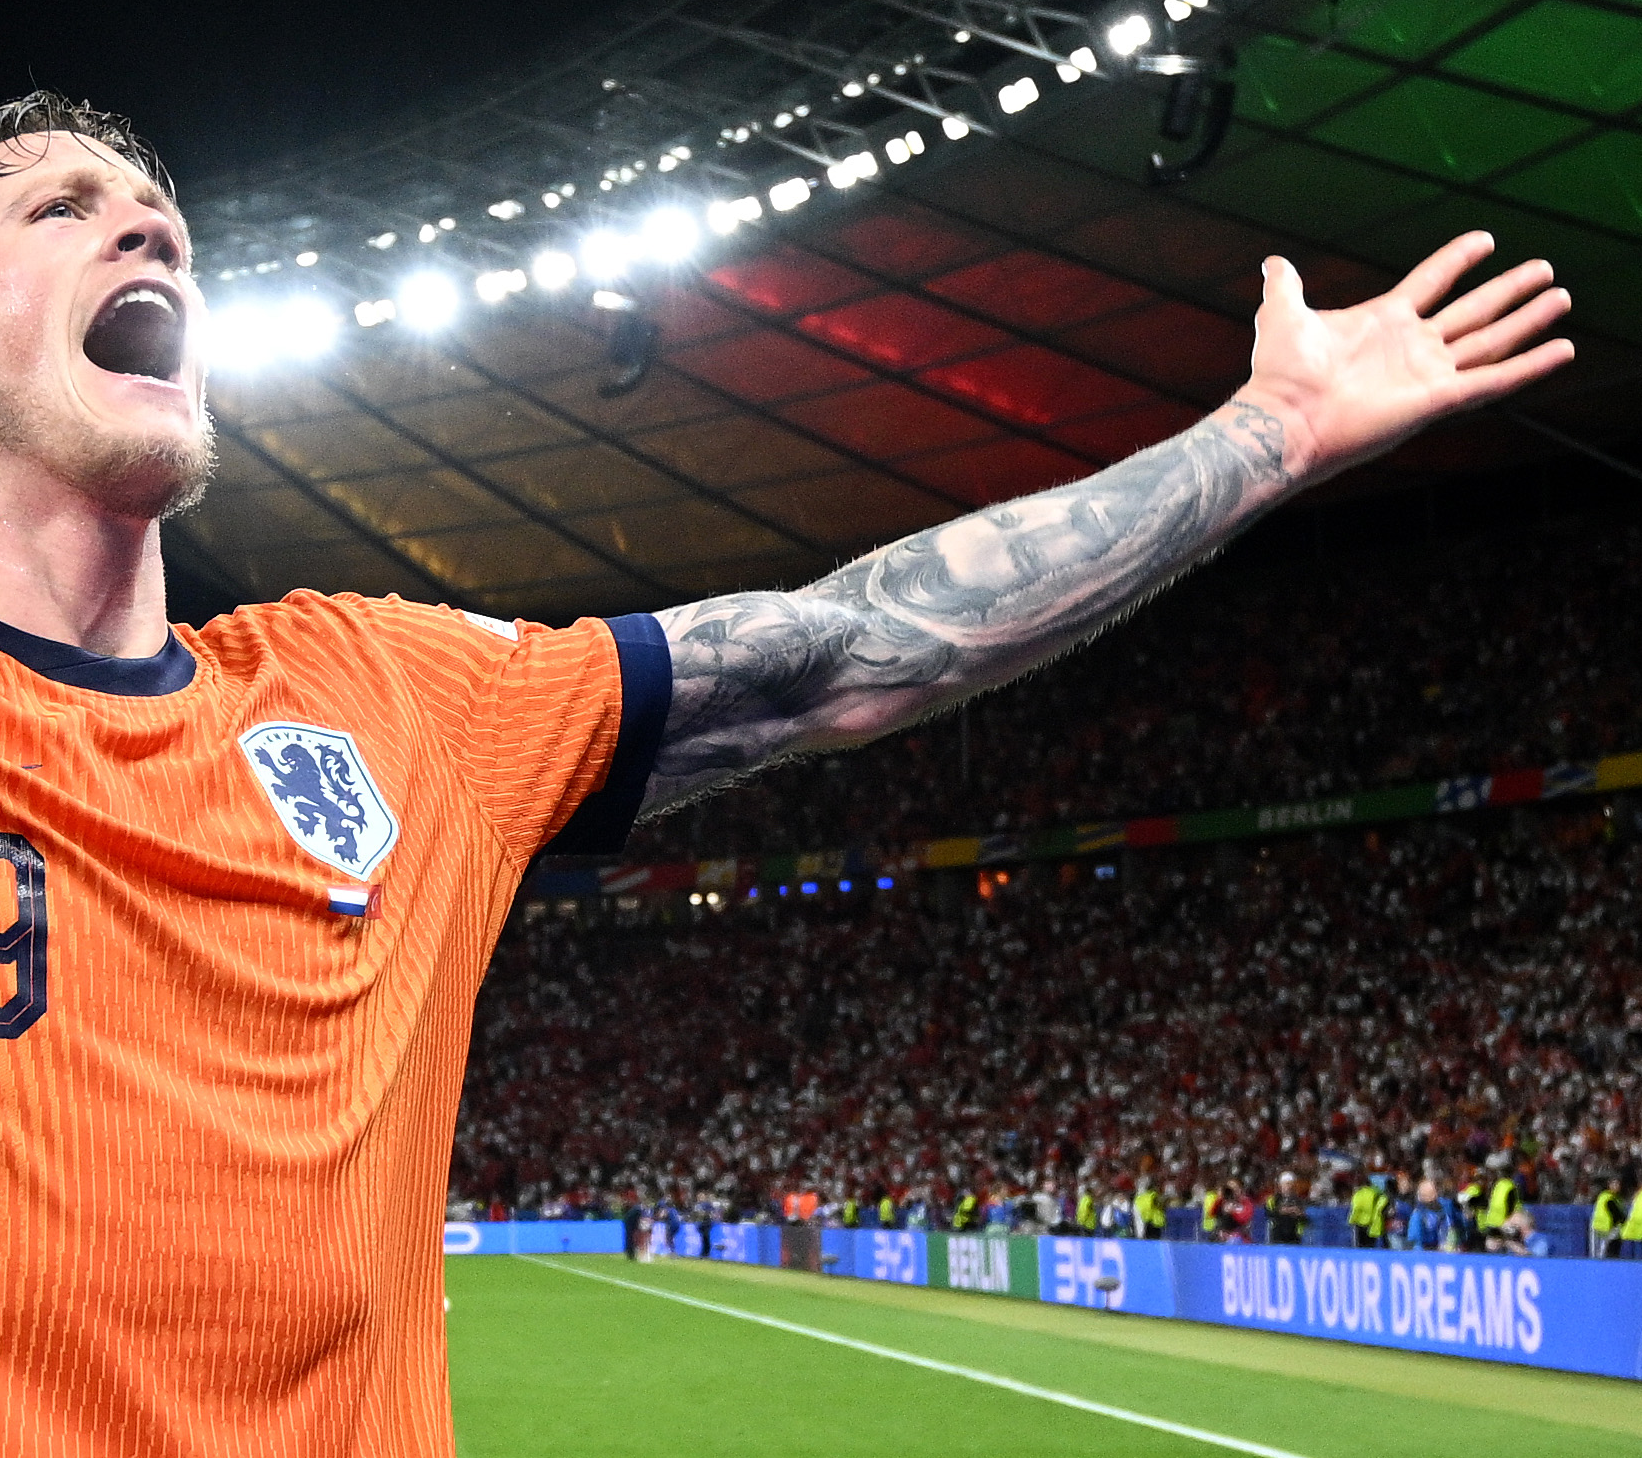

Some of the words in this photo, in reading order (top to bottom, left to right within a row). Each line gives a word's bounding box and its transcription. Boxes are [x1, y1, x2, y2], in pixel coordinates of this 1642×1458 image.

[1257, 799, 1354, 831] BERLIN
[948, 1236, 1011, 1292] BERLIN
[1055, 1238, 1126, 1309] BYD
[1221, 1253, 1295, 1323] BUILD
[1300, 1257, 1384, 1333] YOUR
[1390, 1261, 1543, 1355] DREAMS
